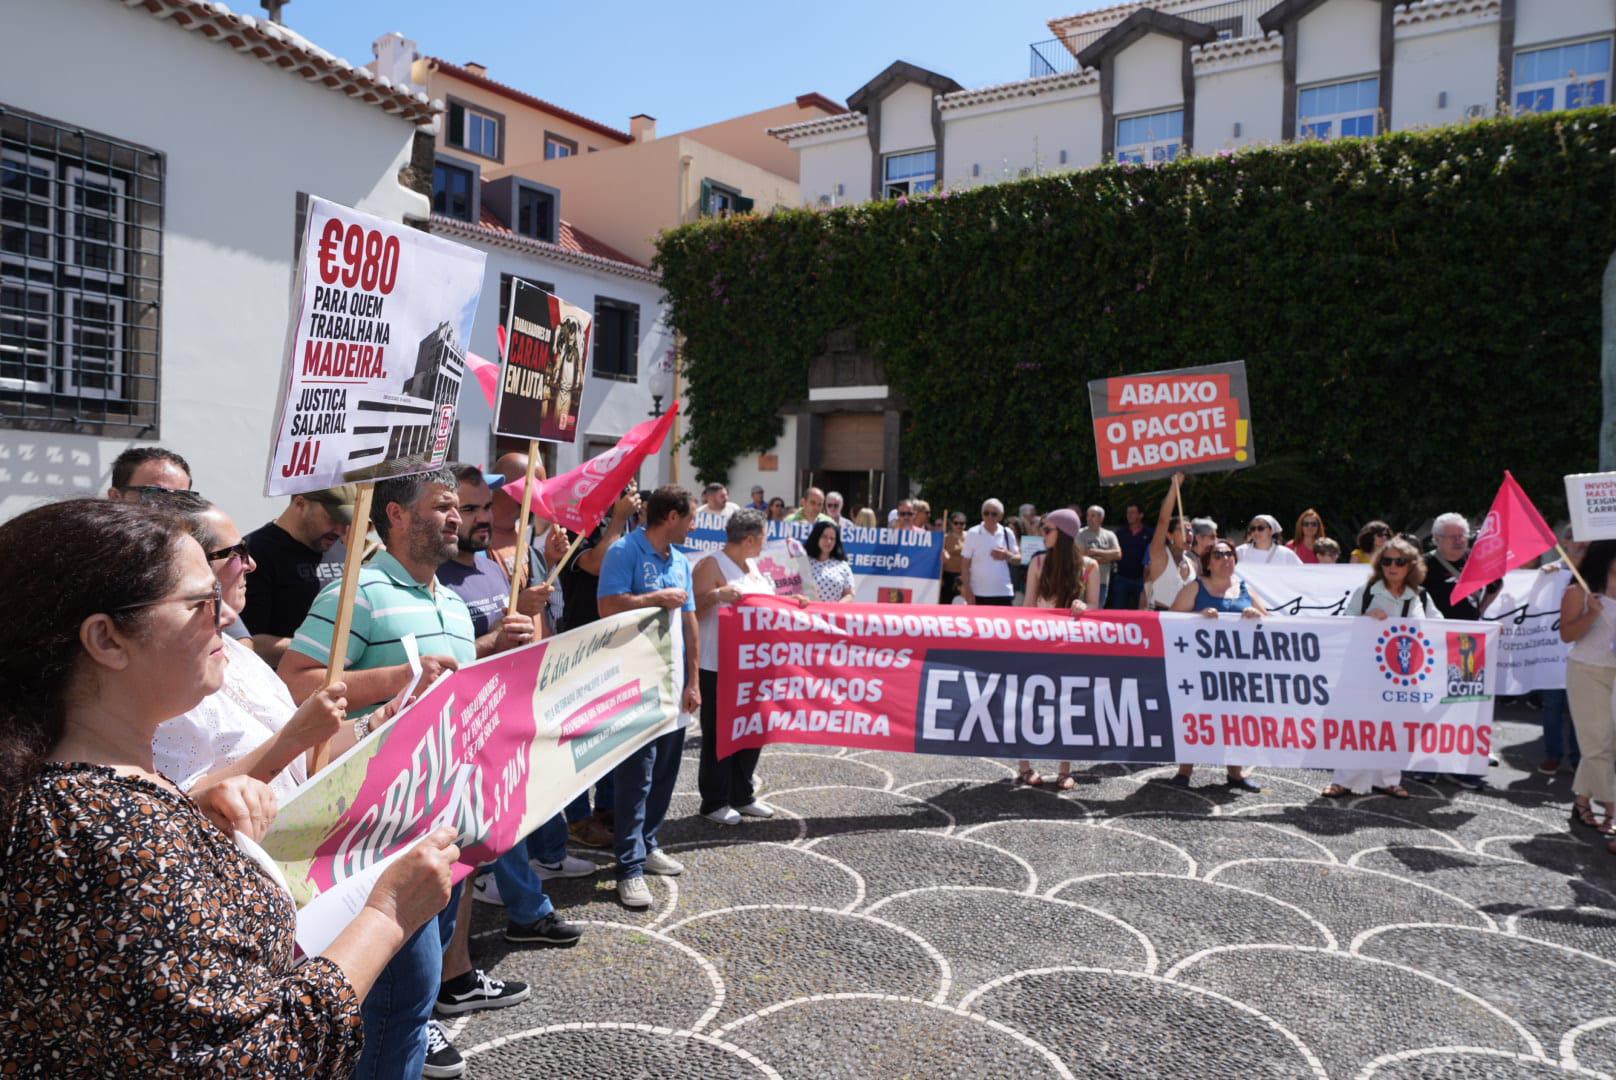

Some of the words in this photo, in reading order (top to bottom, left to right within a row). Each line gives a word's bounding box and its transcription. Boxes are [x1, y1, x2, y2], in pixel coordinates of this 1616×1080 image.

[317, 218, 400, 295] €980
[313, 285, 348, 314] PARA
[349, 292, 384, 319] QUEM
[309, 313, 374, 343] TRABALHA
[373, 321, 390, 345] NA
[302, 340, 387, 379] MADEIRA.
[510, 330, 550, 370] CARAM
[505, 364, 521, 395] EM
[519, 368, 544, 401] LUTA
[1119, 381, 1217, 406] ABAIXO
[295, 388, 347, 412] JUSTIÇA
[290, 412, 346, 436] SALARIAL
[1106, 422, 1127, 443] O
[1132, 407, 1227, 441] PACOTE
[282, 436, 320, 477] JÁ!
[1110, 433, 1230, 470] LABORAL
[879, 528, 898, 545] EM
[900, 529, 932, 547] LUTA
[855, 553, 910, 570] REFEIÇÃO
[738, 606, 973, 638] TRABALHADORES
[973, 616, 1012, 639] DO
[738, 640, 913, 670] ESCRITÓRIOS
[1174, 636, 1189, 653] +
[1195, 624, 1321, 662] SALÁRIO
[736, 682, 754, 707] E
[754, 676, 884, 705] SERVIÇOS
[1178, 678, 1194, 695] +
[1200, 670, 1330, 706] DIREITOS
[1382, 690, 1434, 704] CESP
[1448, 681, 1484, 696] CGTP
[731, 711, 764, 741] DA
[767, 709, 891, 736] MADEIRA
[922, 668, 1163, 748] EXIGEM:
[1182, 713, 1216, 746] 35
[1221, 714, 1317, 750] HORAS
[1322, 718, 1398, 752] PARA
[1403, 721, 1492, 757] TODOS
[333, 692, 460, 884] GREVE
